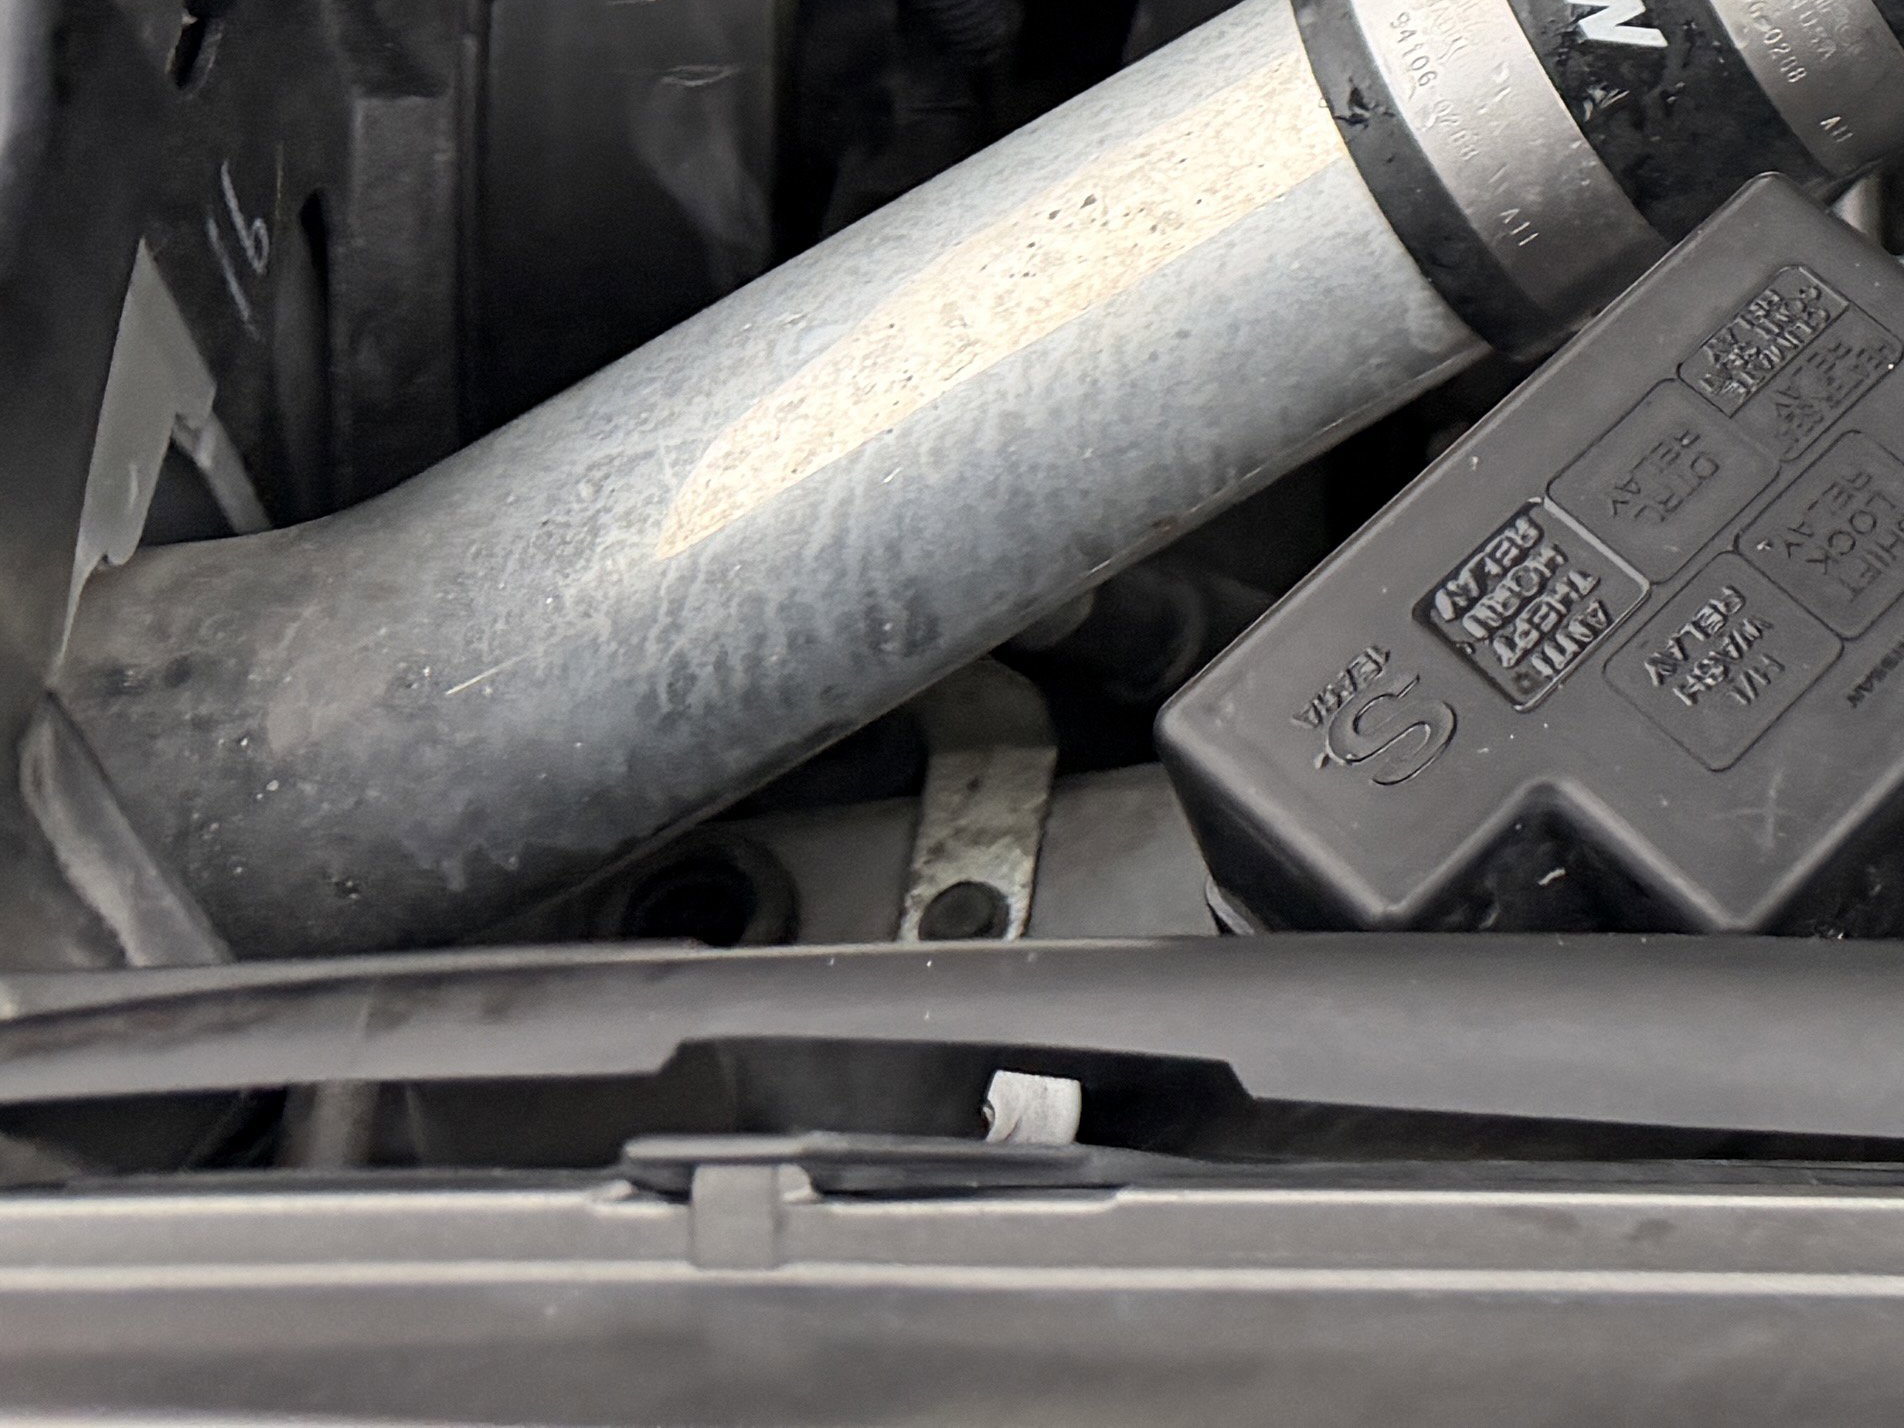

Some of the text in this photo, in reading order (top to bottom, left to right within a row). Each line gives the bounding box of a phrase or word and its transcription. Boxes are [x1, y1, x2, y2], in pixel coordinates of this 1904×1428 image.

[1611, 430, 1701, 517] RELAY
[1784, 470, 1873, 559] RELAY
[1434, 514, 1545, 623] RELAY
[1806, 491, 1897, 575] LOCK
[1462, 543, 1568, 641] HORN
[1493, 570, 1601, 669] THEFT
[1644, 585, 1747, 687] RELAY
[1672, 618, 1775, 706] WASH
